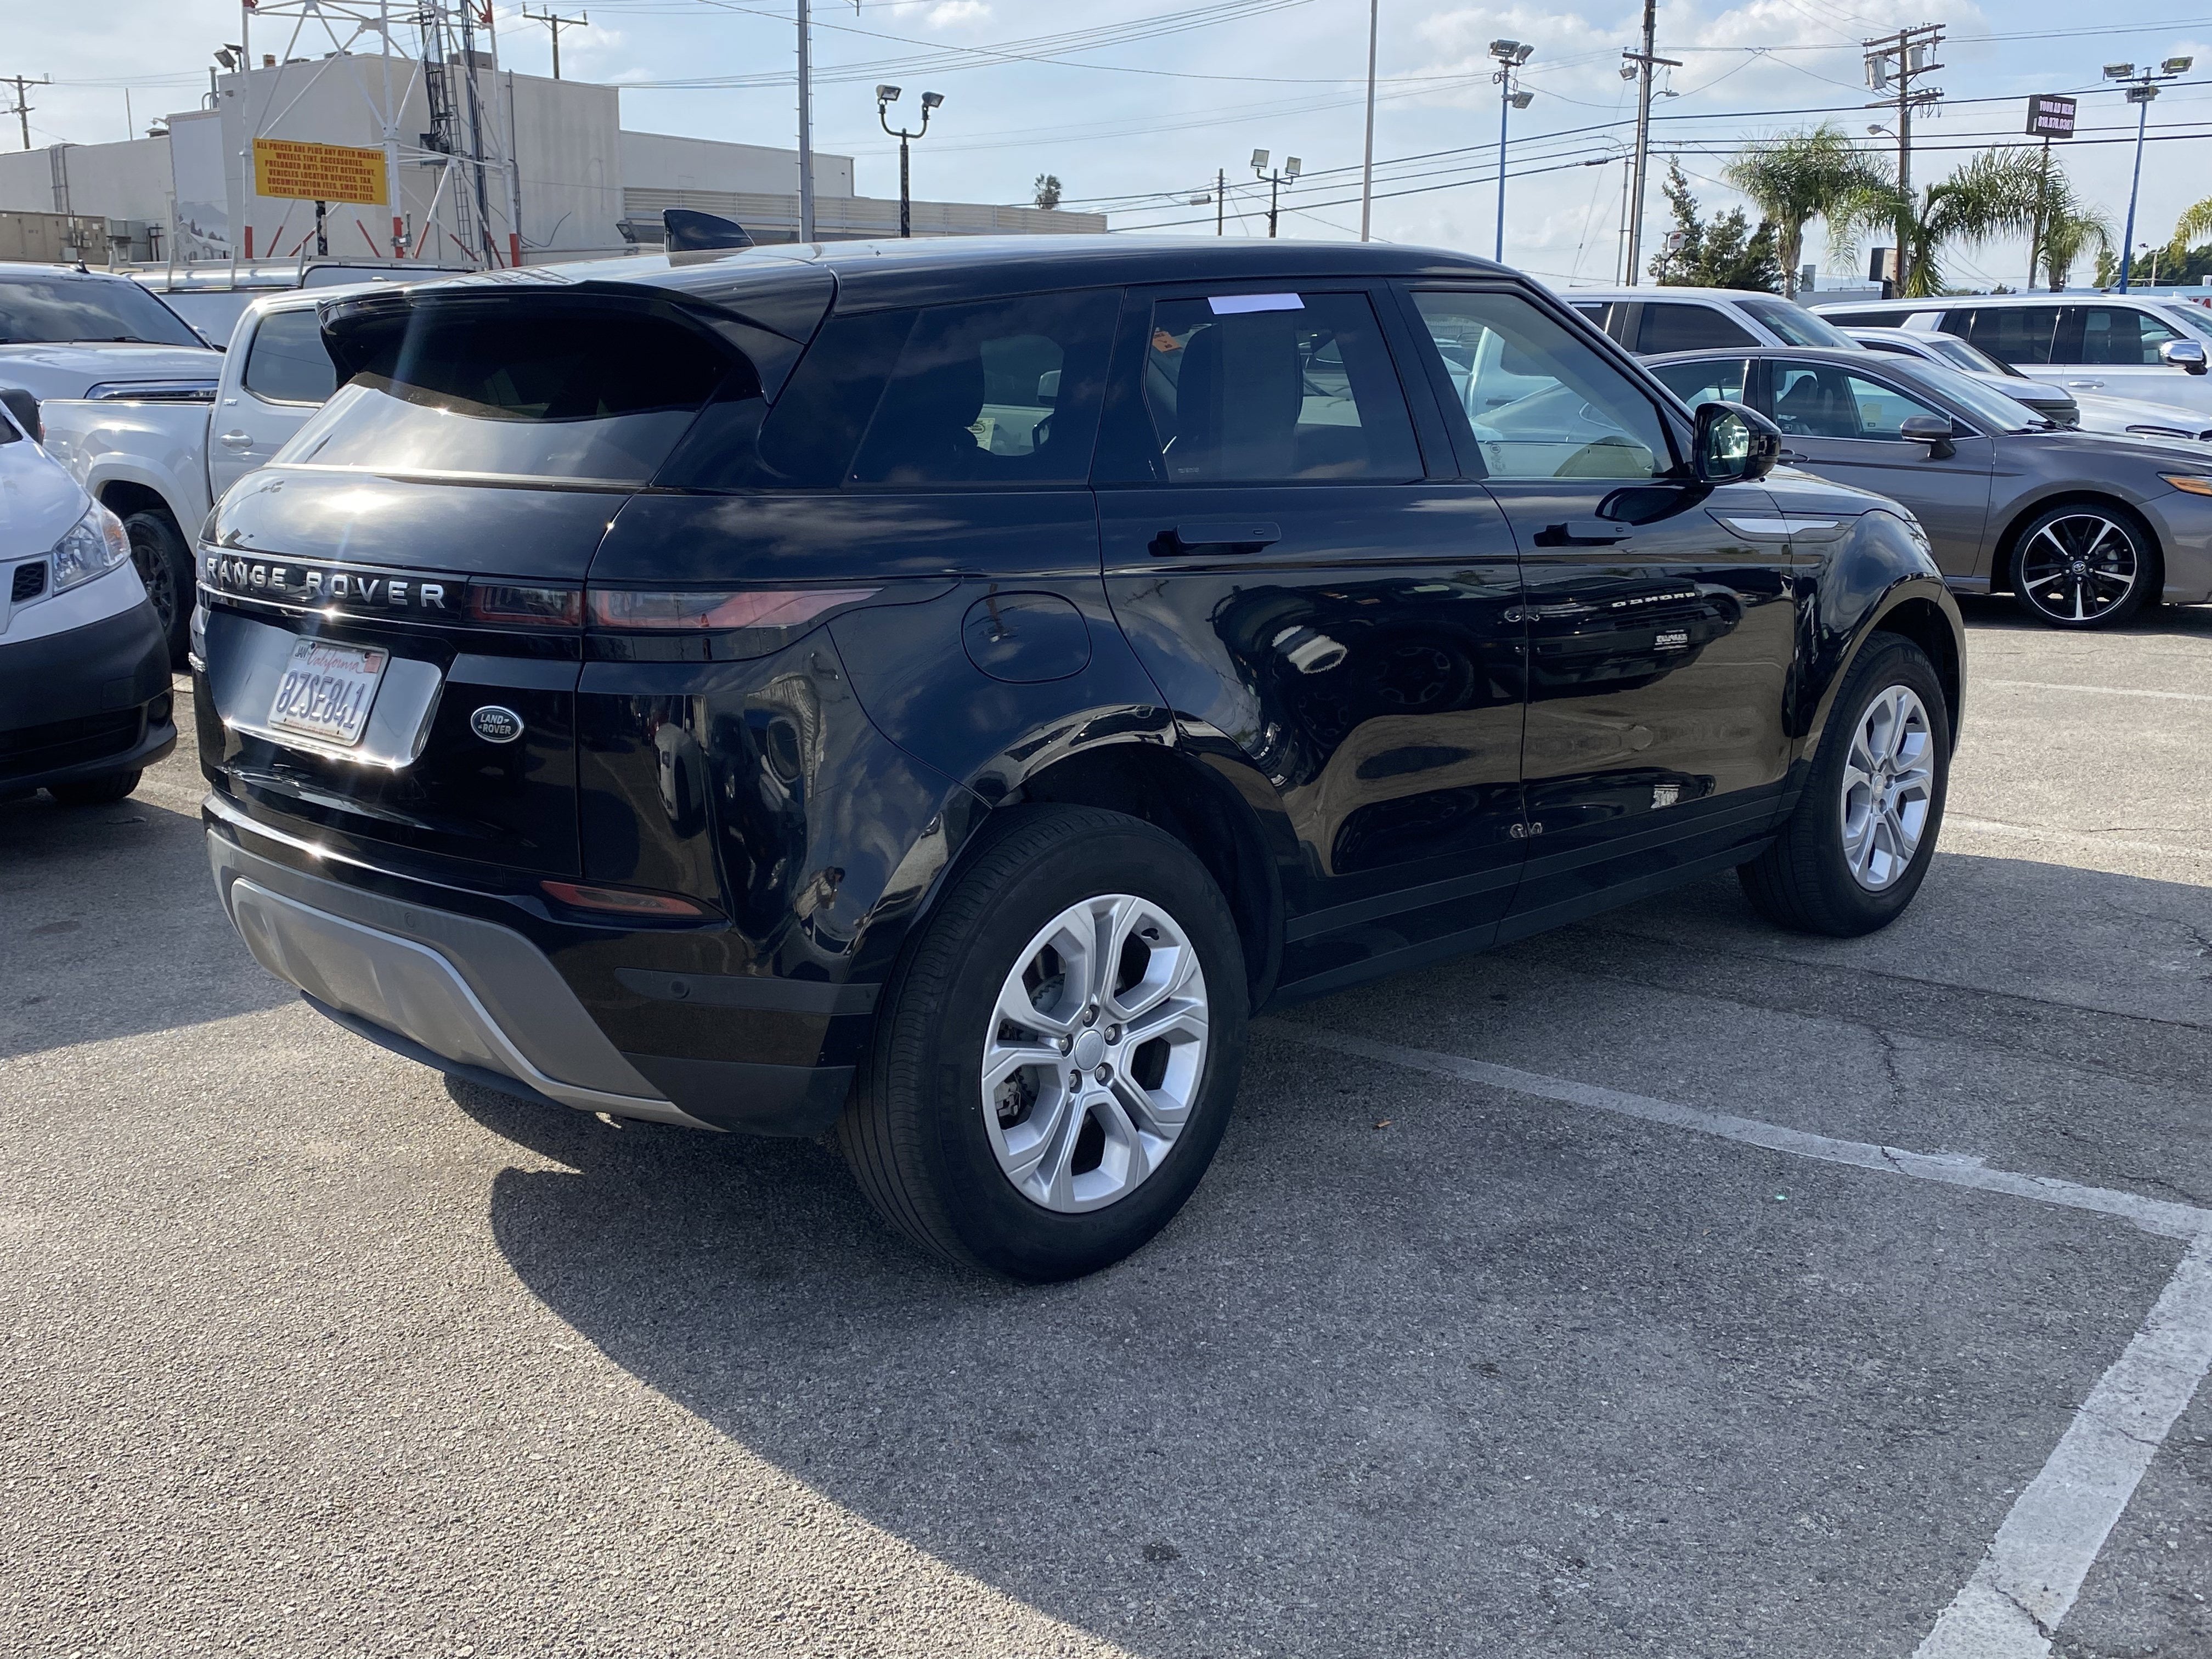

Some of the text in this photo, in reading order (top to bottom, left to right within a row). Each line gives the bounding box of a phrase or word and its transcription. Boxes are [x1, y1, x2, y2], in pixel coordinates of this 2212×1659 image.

[2040, 100, 2074, 115] YOUR AD HERE
[269, 143, 292, 151] PRICES
[357, 152, 381, 160] MARKET
[265, 160, 301, 169] PRELOADED
[303, 163, 338, 173] ANTI-THEFT
[269, 169, 299, 178] VEHICLES
[301, 172, 329, 180] LOCATOR
[268, 177, 320, 188] DOCUMENTATION
[313, 189, 357, 199] REGISTRATION
[206, 557, 445, 608] RANGE ROVER
[307, 648, 364, 675] California
[276, 669, 365, 729] 8ZSE841
[480, 714, 504, 724] LAND
[483, 724, 512, 735] ROVER
